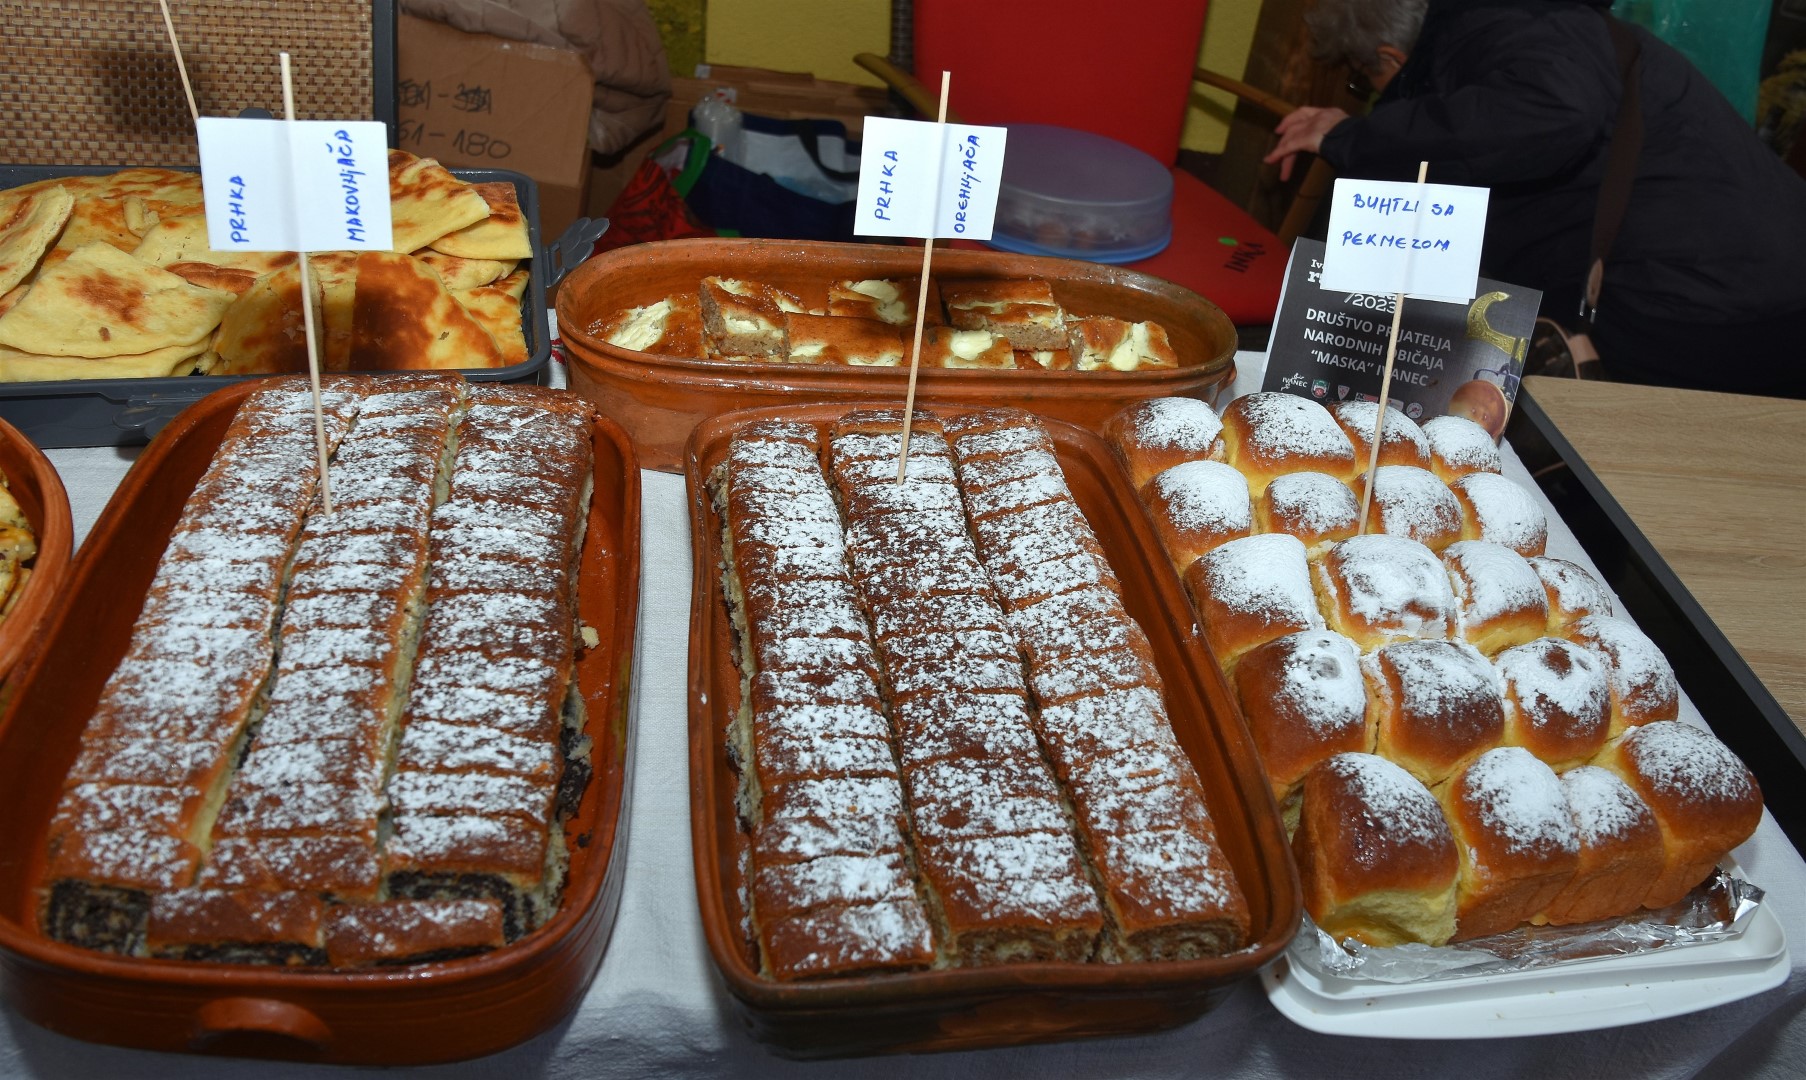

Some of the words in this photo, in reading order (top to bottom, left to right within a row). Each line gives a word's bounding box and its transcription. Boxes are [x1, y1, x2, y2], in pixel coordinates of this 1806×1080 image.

[874, 150, 898, 221] PRHKA
[1353, 193, 1419, 216] BUHTLI
[1431, 203, 1455, 216] SA
[228, 175, 250, 243] PRHKA
[1303, 328, 1383, 356] NARODNIH
[1306, 308, 1373, 333] DRUŠTVO
[1376, 324, 1452, 352] PRJATELJA
